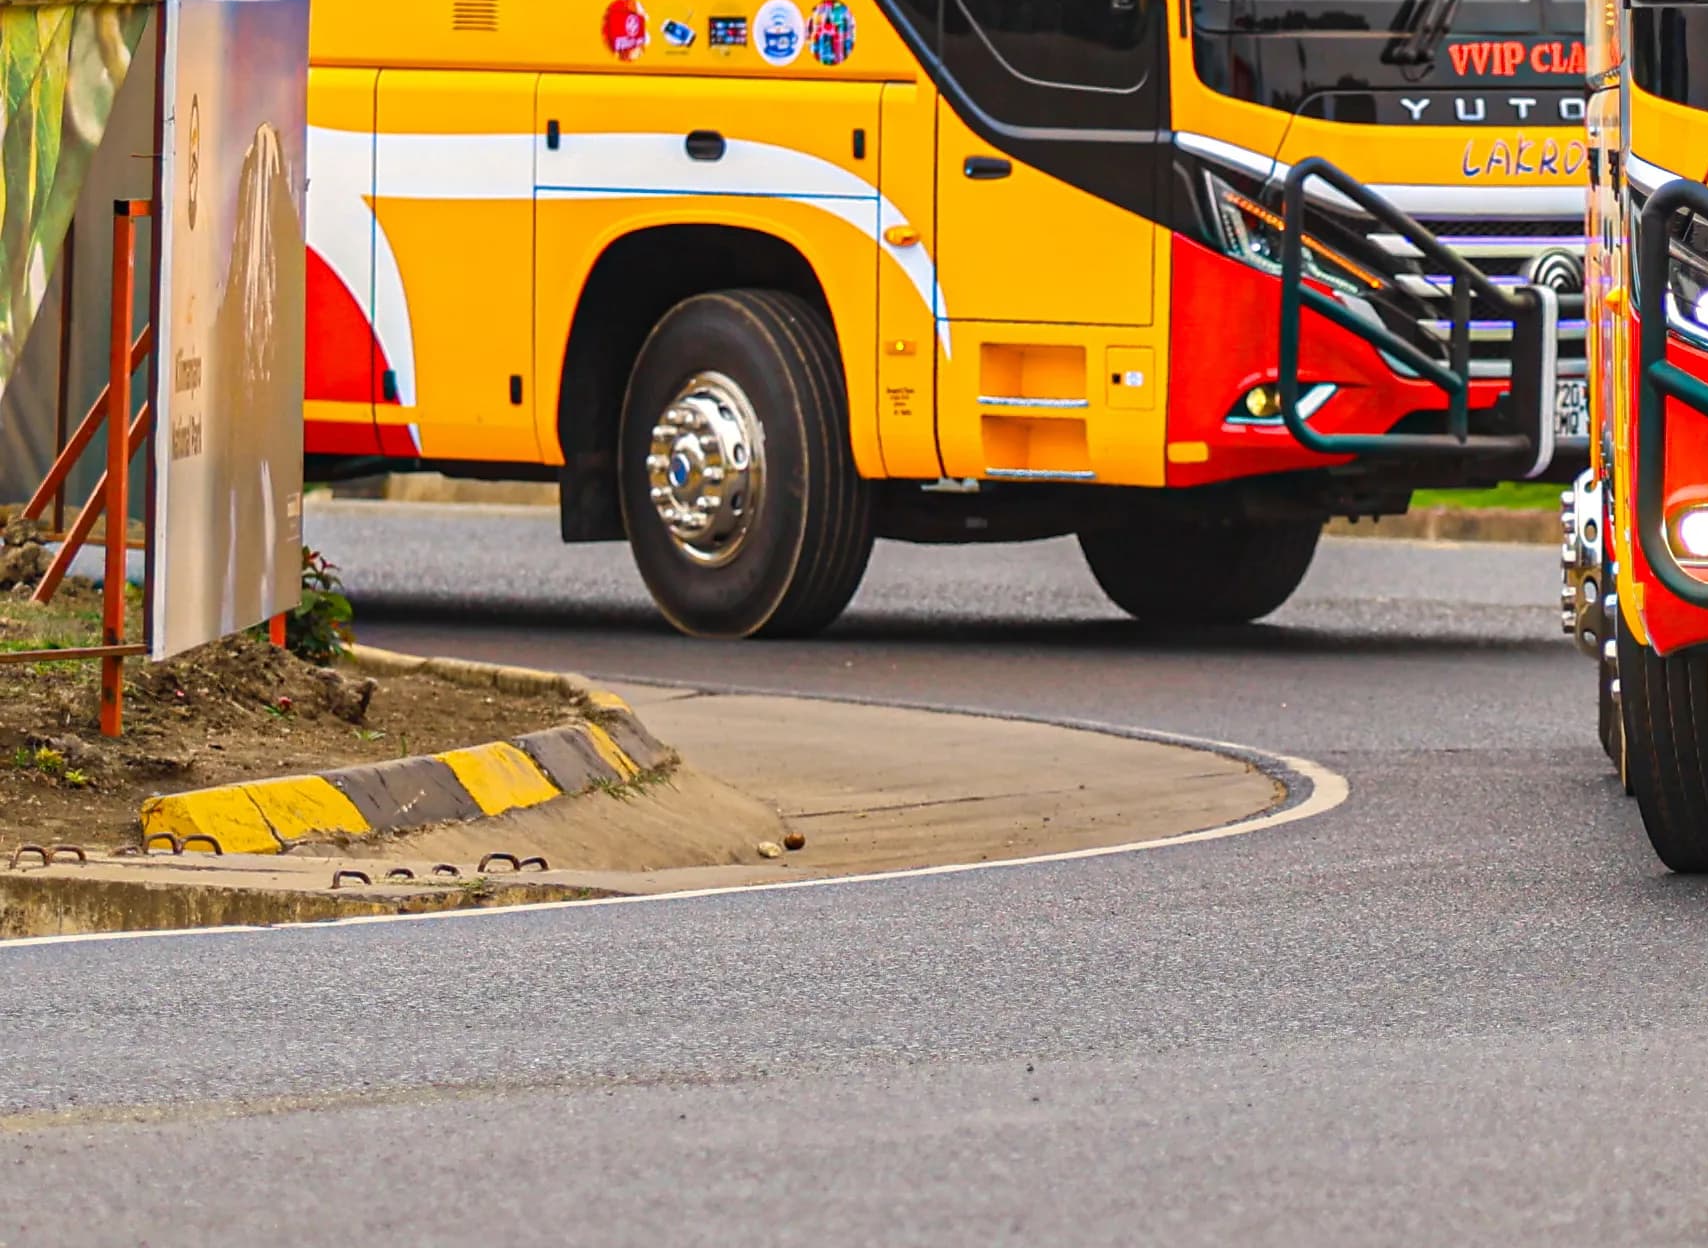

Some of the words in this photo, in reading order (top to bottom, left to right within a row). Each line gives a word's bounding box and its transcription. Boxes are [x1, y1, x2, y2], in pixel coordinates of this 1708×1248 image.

[1448, 41, 1527, 77] VVIP
[1401, 97, 1585, 122] YUTO
[1462, 131, 1587, 177] LAKRO
